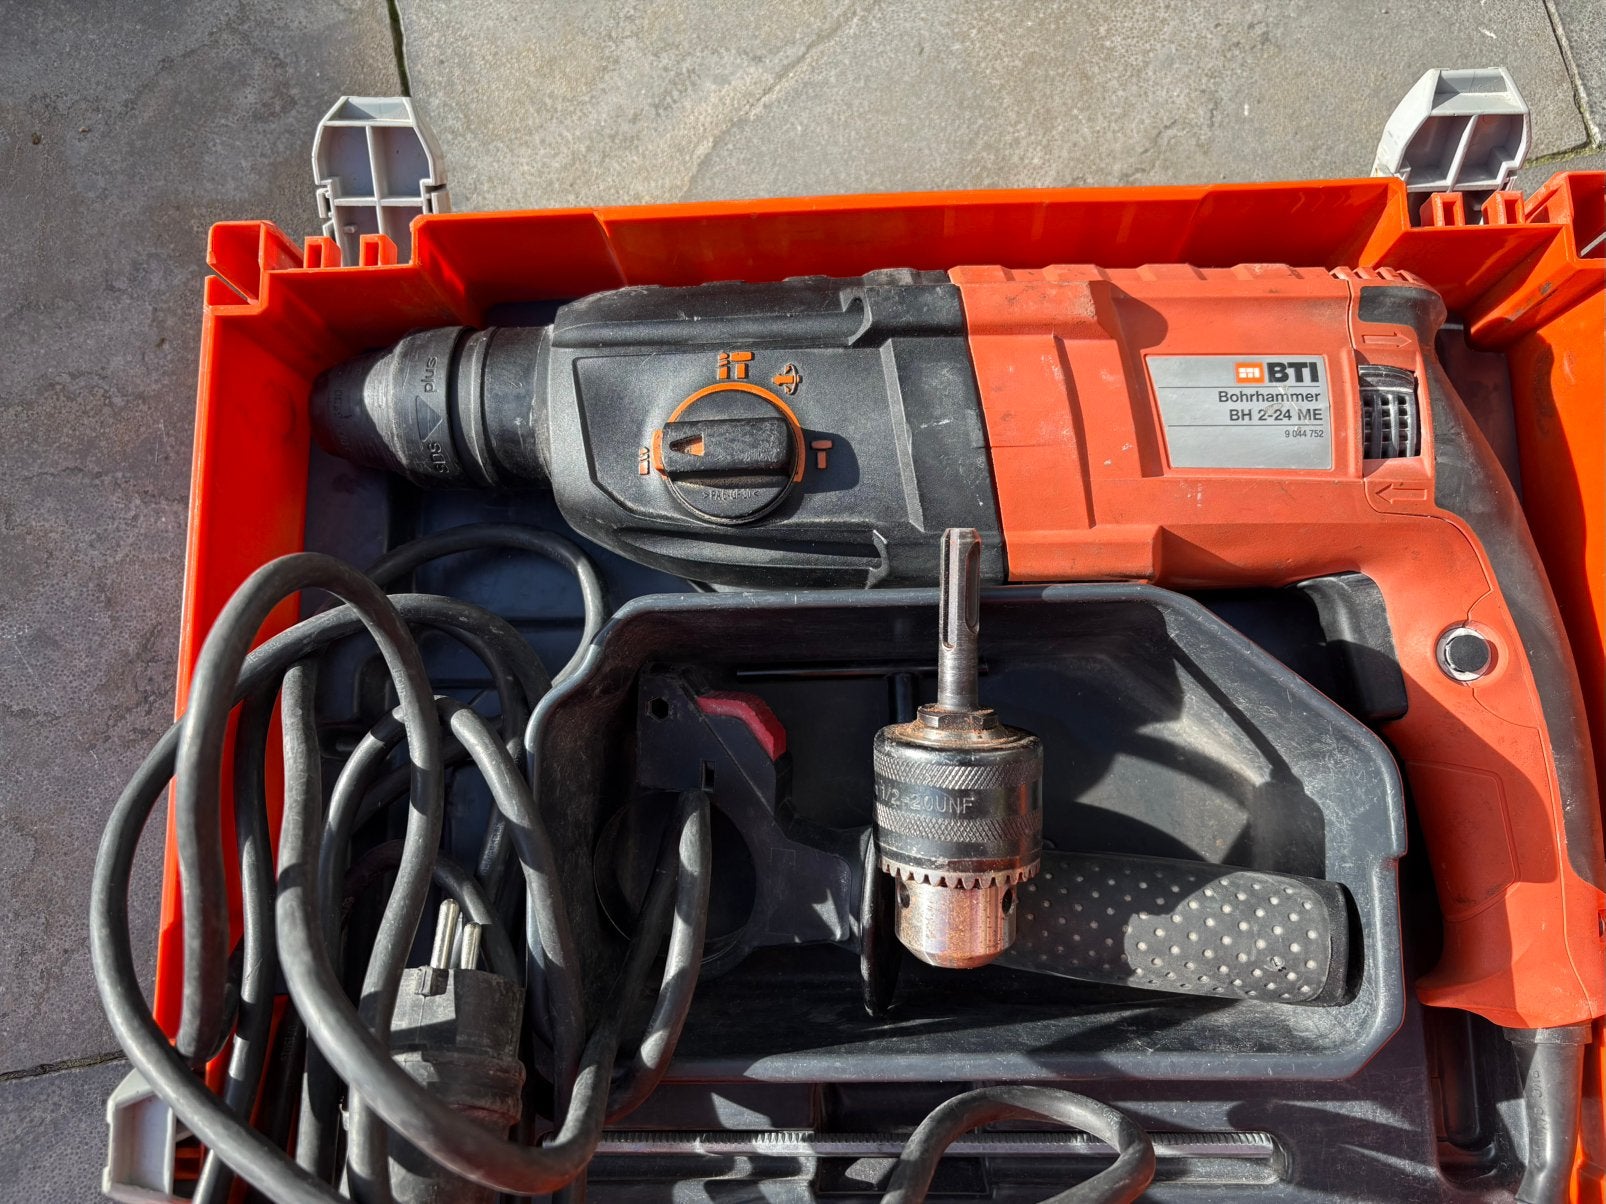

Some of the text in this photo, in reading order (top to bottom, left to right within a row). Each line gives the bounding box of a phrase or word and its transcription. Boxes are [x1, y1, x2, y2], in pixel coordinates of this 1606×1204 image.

[421, 356, 438, 393] plus
[1266, 361, 1320, 383] BTI
[1218, 390, 1321, 403] Bohrhammer
[1229, 408, 1323, 422] BH 2-24 ME
[1284, 430, 1324, 438] 9 044 752
